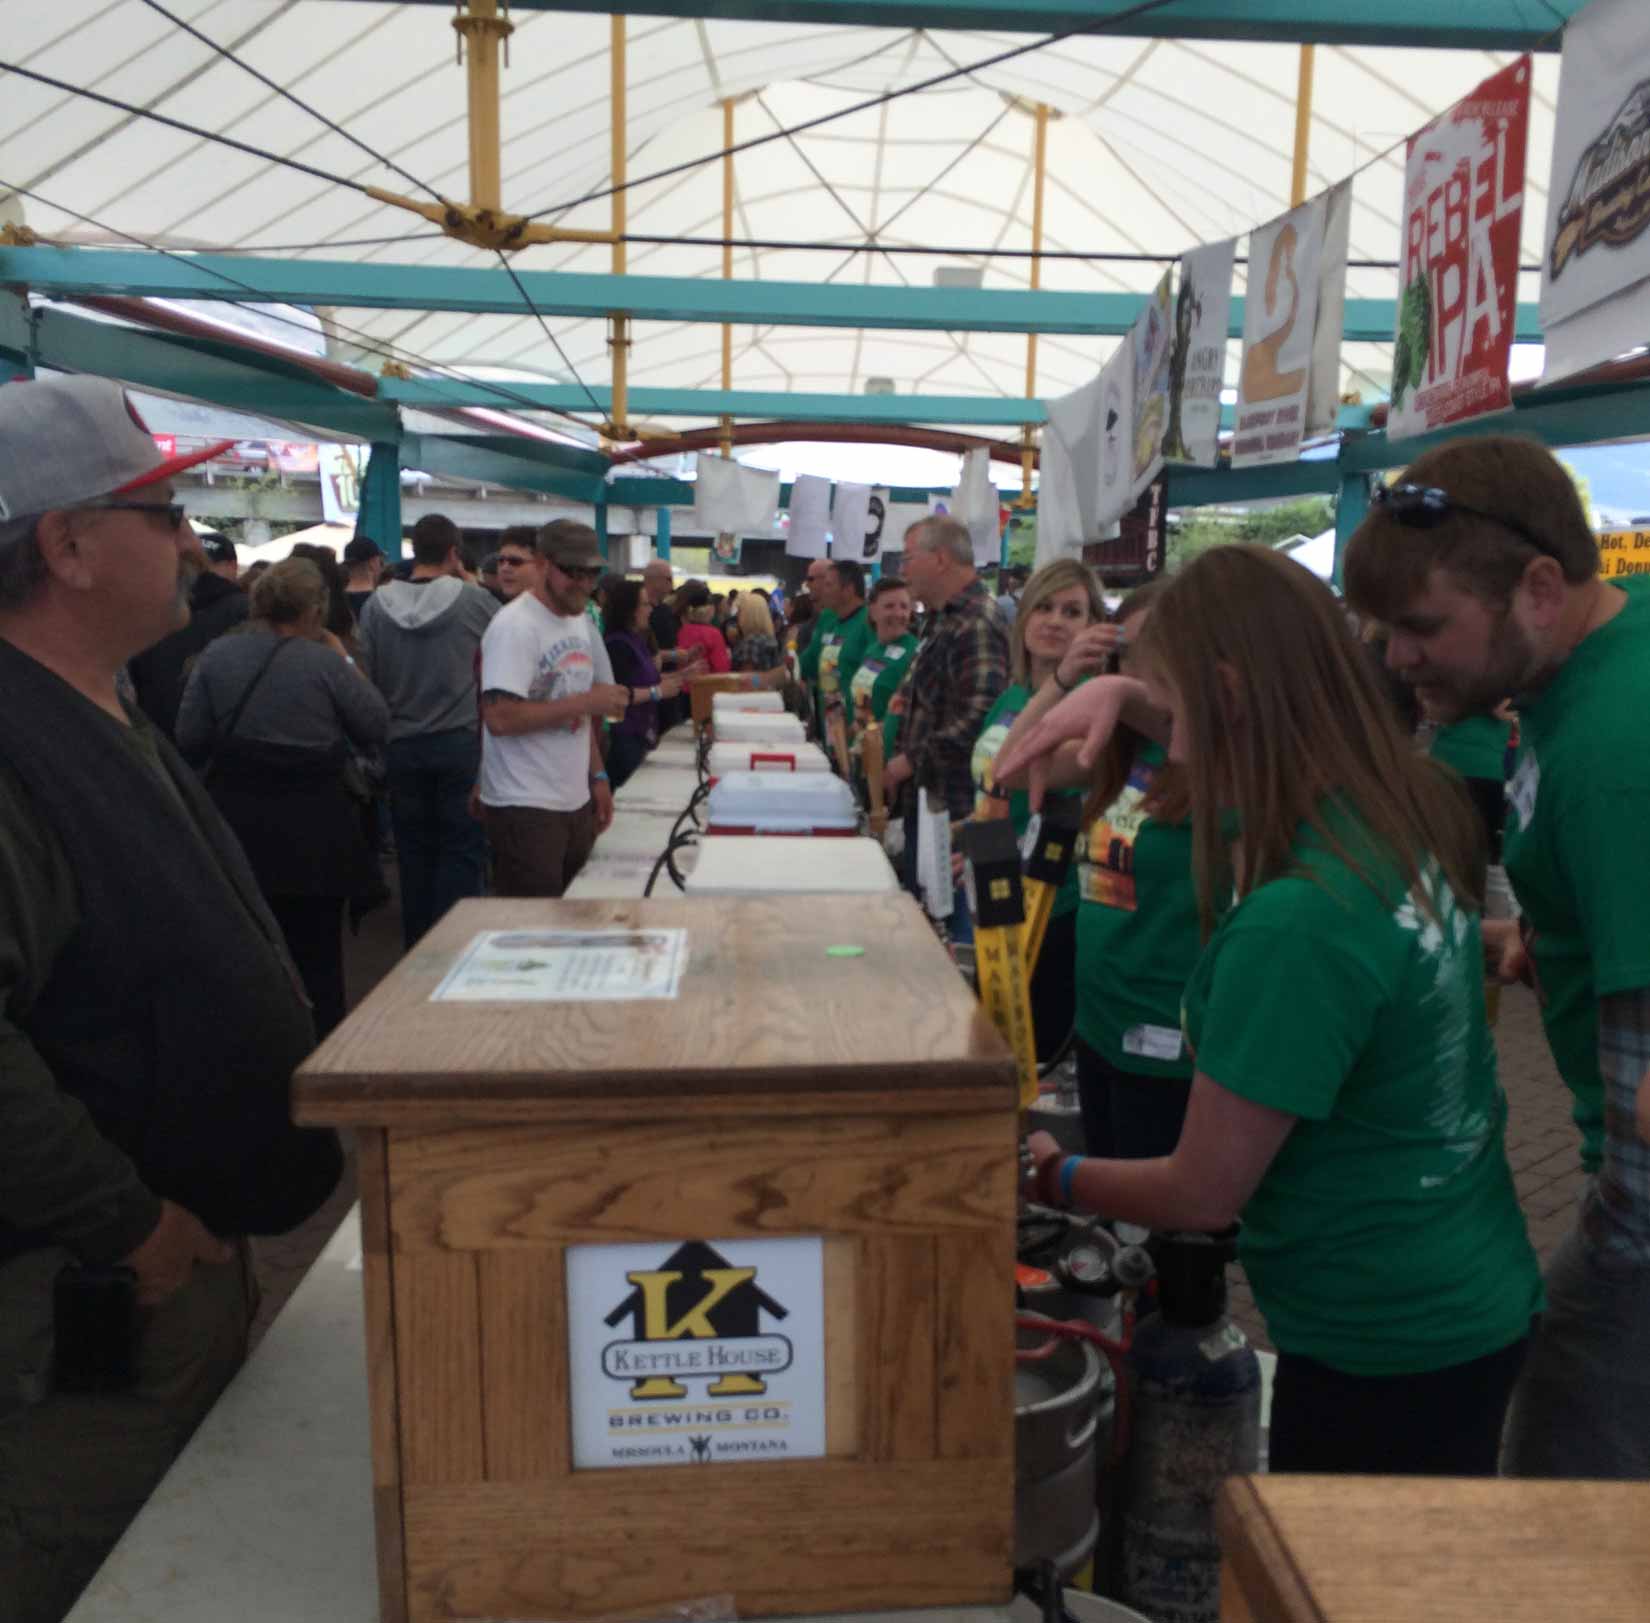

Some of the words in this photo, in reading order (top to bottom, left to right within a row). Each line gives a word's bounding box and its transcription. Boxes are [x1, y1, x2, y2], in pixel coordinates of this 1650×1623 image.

[1406, 118, 1523, 281] REBEL
[1430, 222, 1502, 385] IPA
[613, 1348, 702, 1371] KETTLE
[707, 1344, 782, 1367] HOUSE
[608, 1408, 733, 1428] BREWING
[744, 1406, 790, 1423] CO.
[716, 1439, 788, 1453] MONTANA
